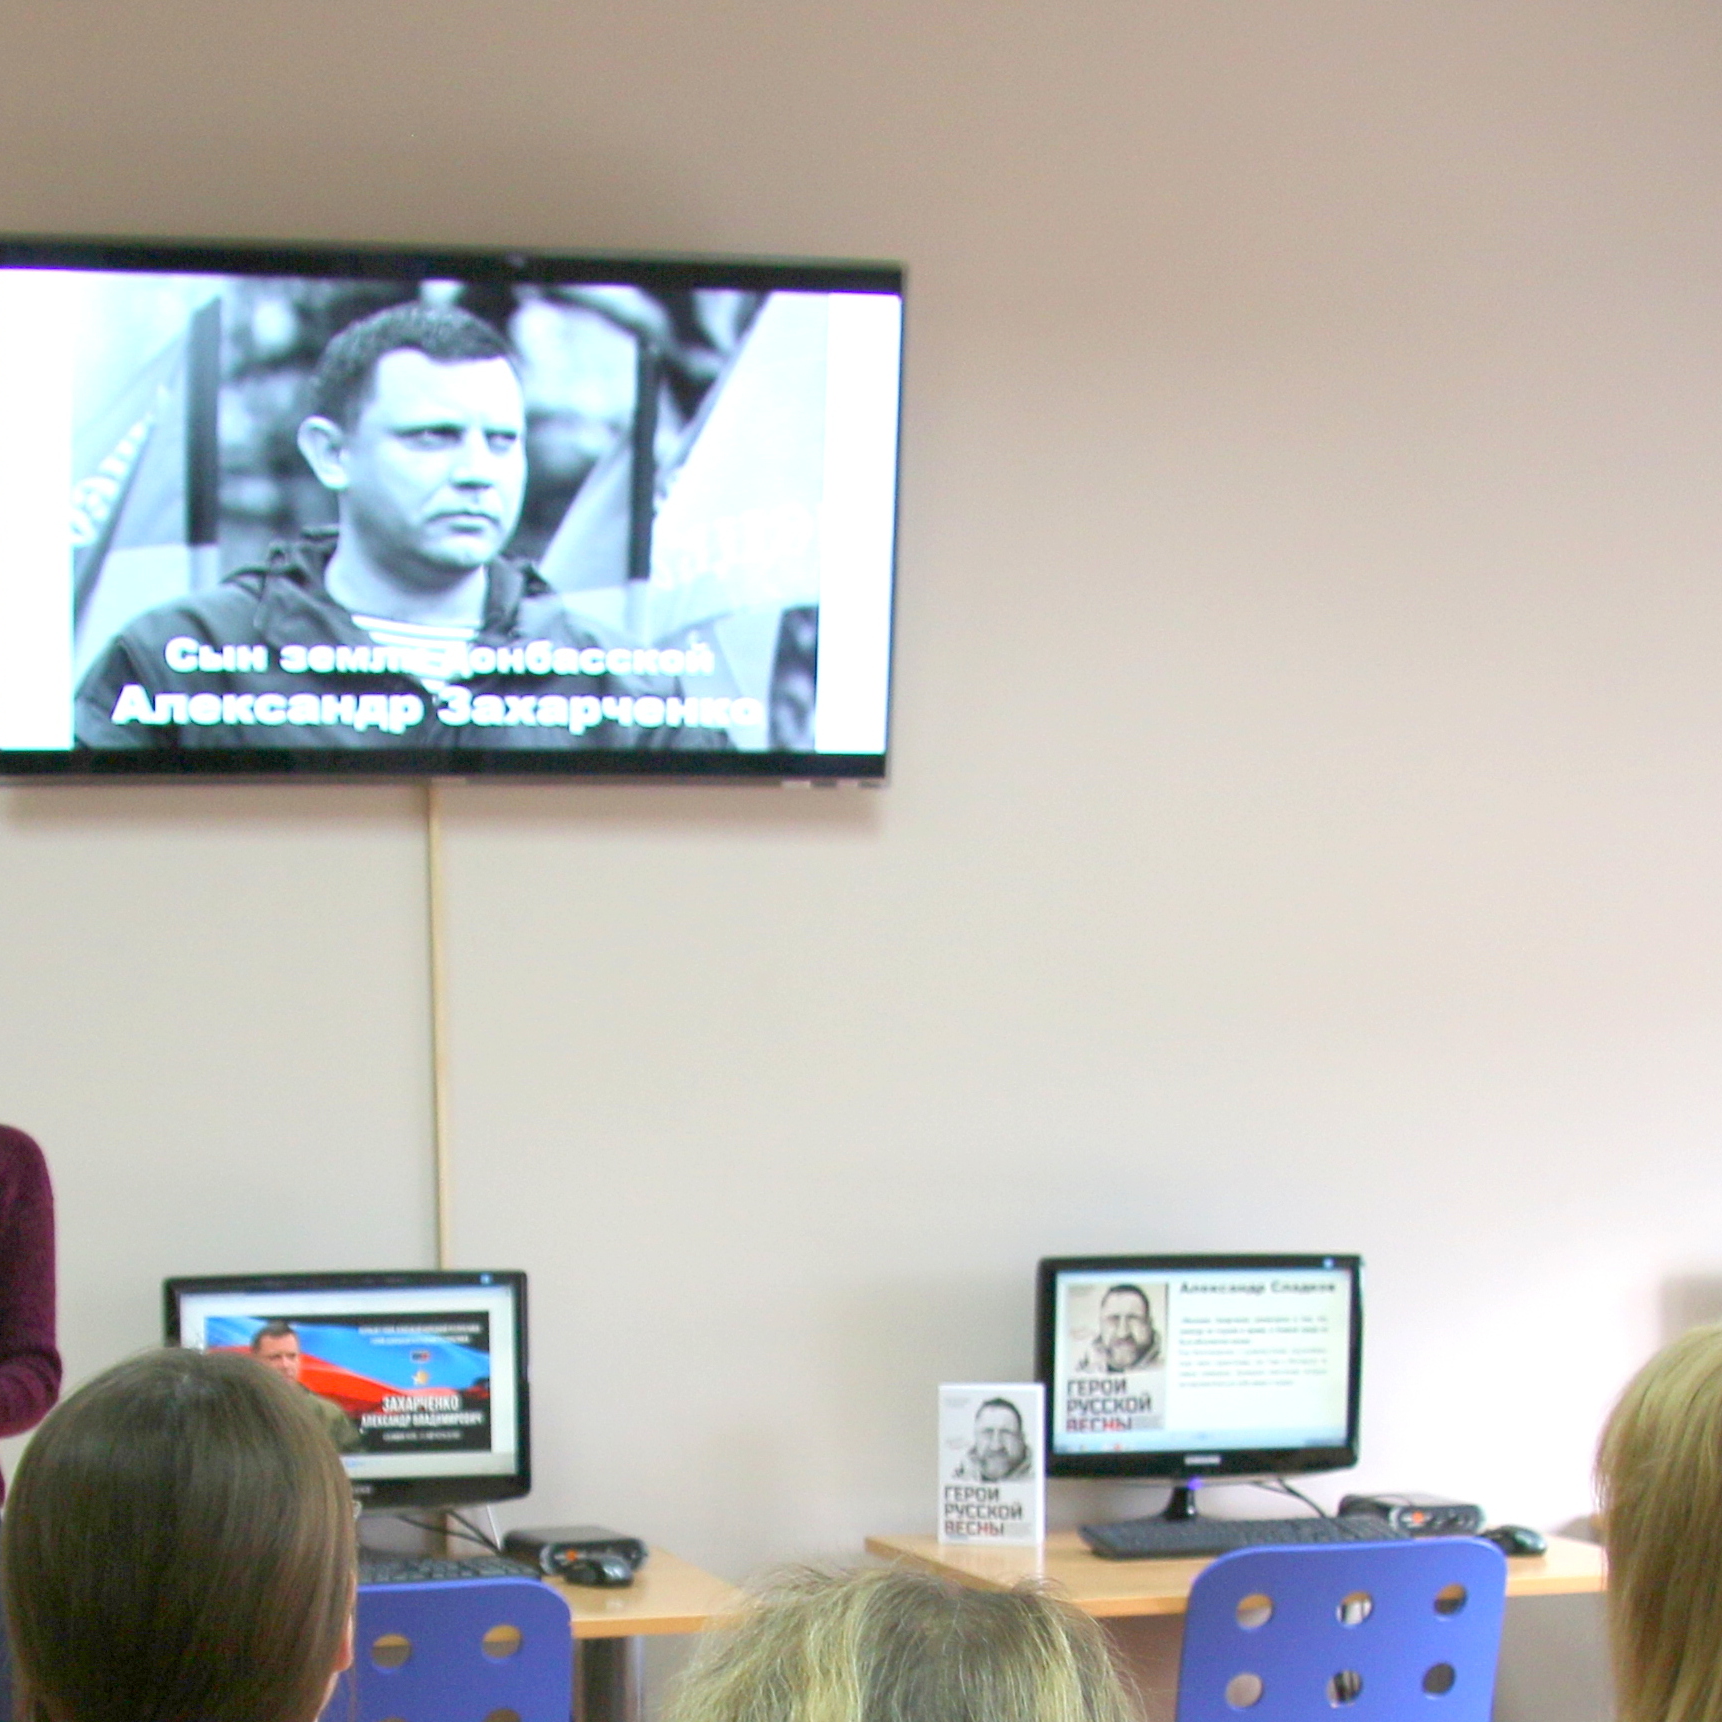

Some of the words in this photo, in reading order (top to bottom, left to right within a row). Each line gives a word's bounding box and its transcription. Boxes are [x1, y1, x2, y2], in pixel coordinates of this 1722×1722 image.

[164, 636, 268, 673] Сын
[279, 644, 431, 676] земл
[439, 633, 715, 681] онбасской
[111, 683, 425, 734] Александр
[436, 685, 765, 735] Захарченко
[1067, 1379, 1127, 1396] ГЕРОИ
[1066, 1393, 1152, 1415] РУССКОЙ
[1065, 1417, 1132, 1432] ВЕСНЫ
[944, 1486, 1000, 1501] ГЕРОИ
[944, 1502, 1022, 1519] РУССКОЙ
[944, 1521, 1004, 1535] ВЕСНЫ
